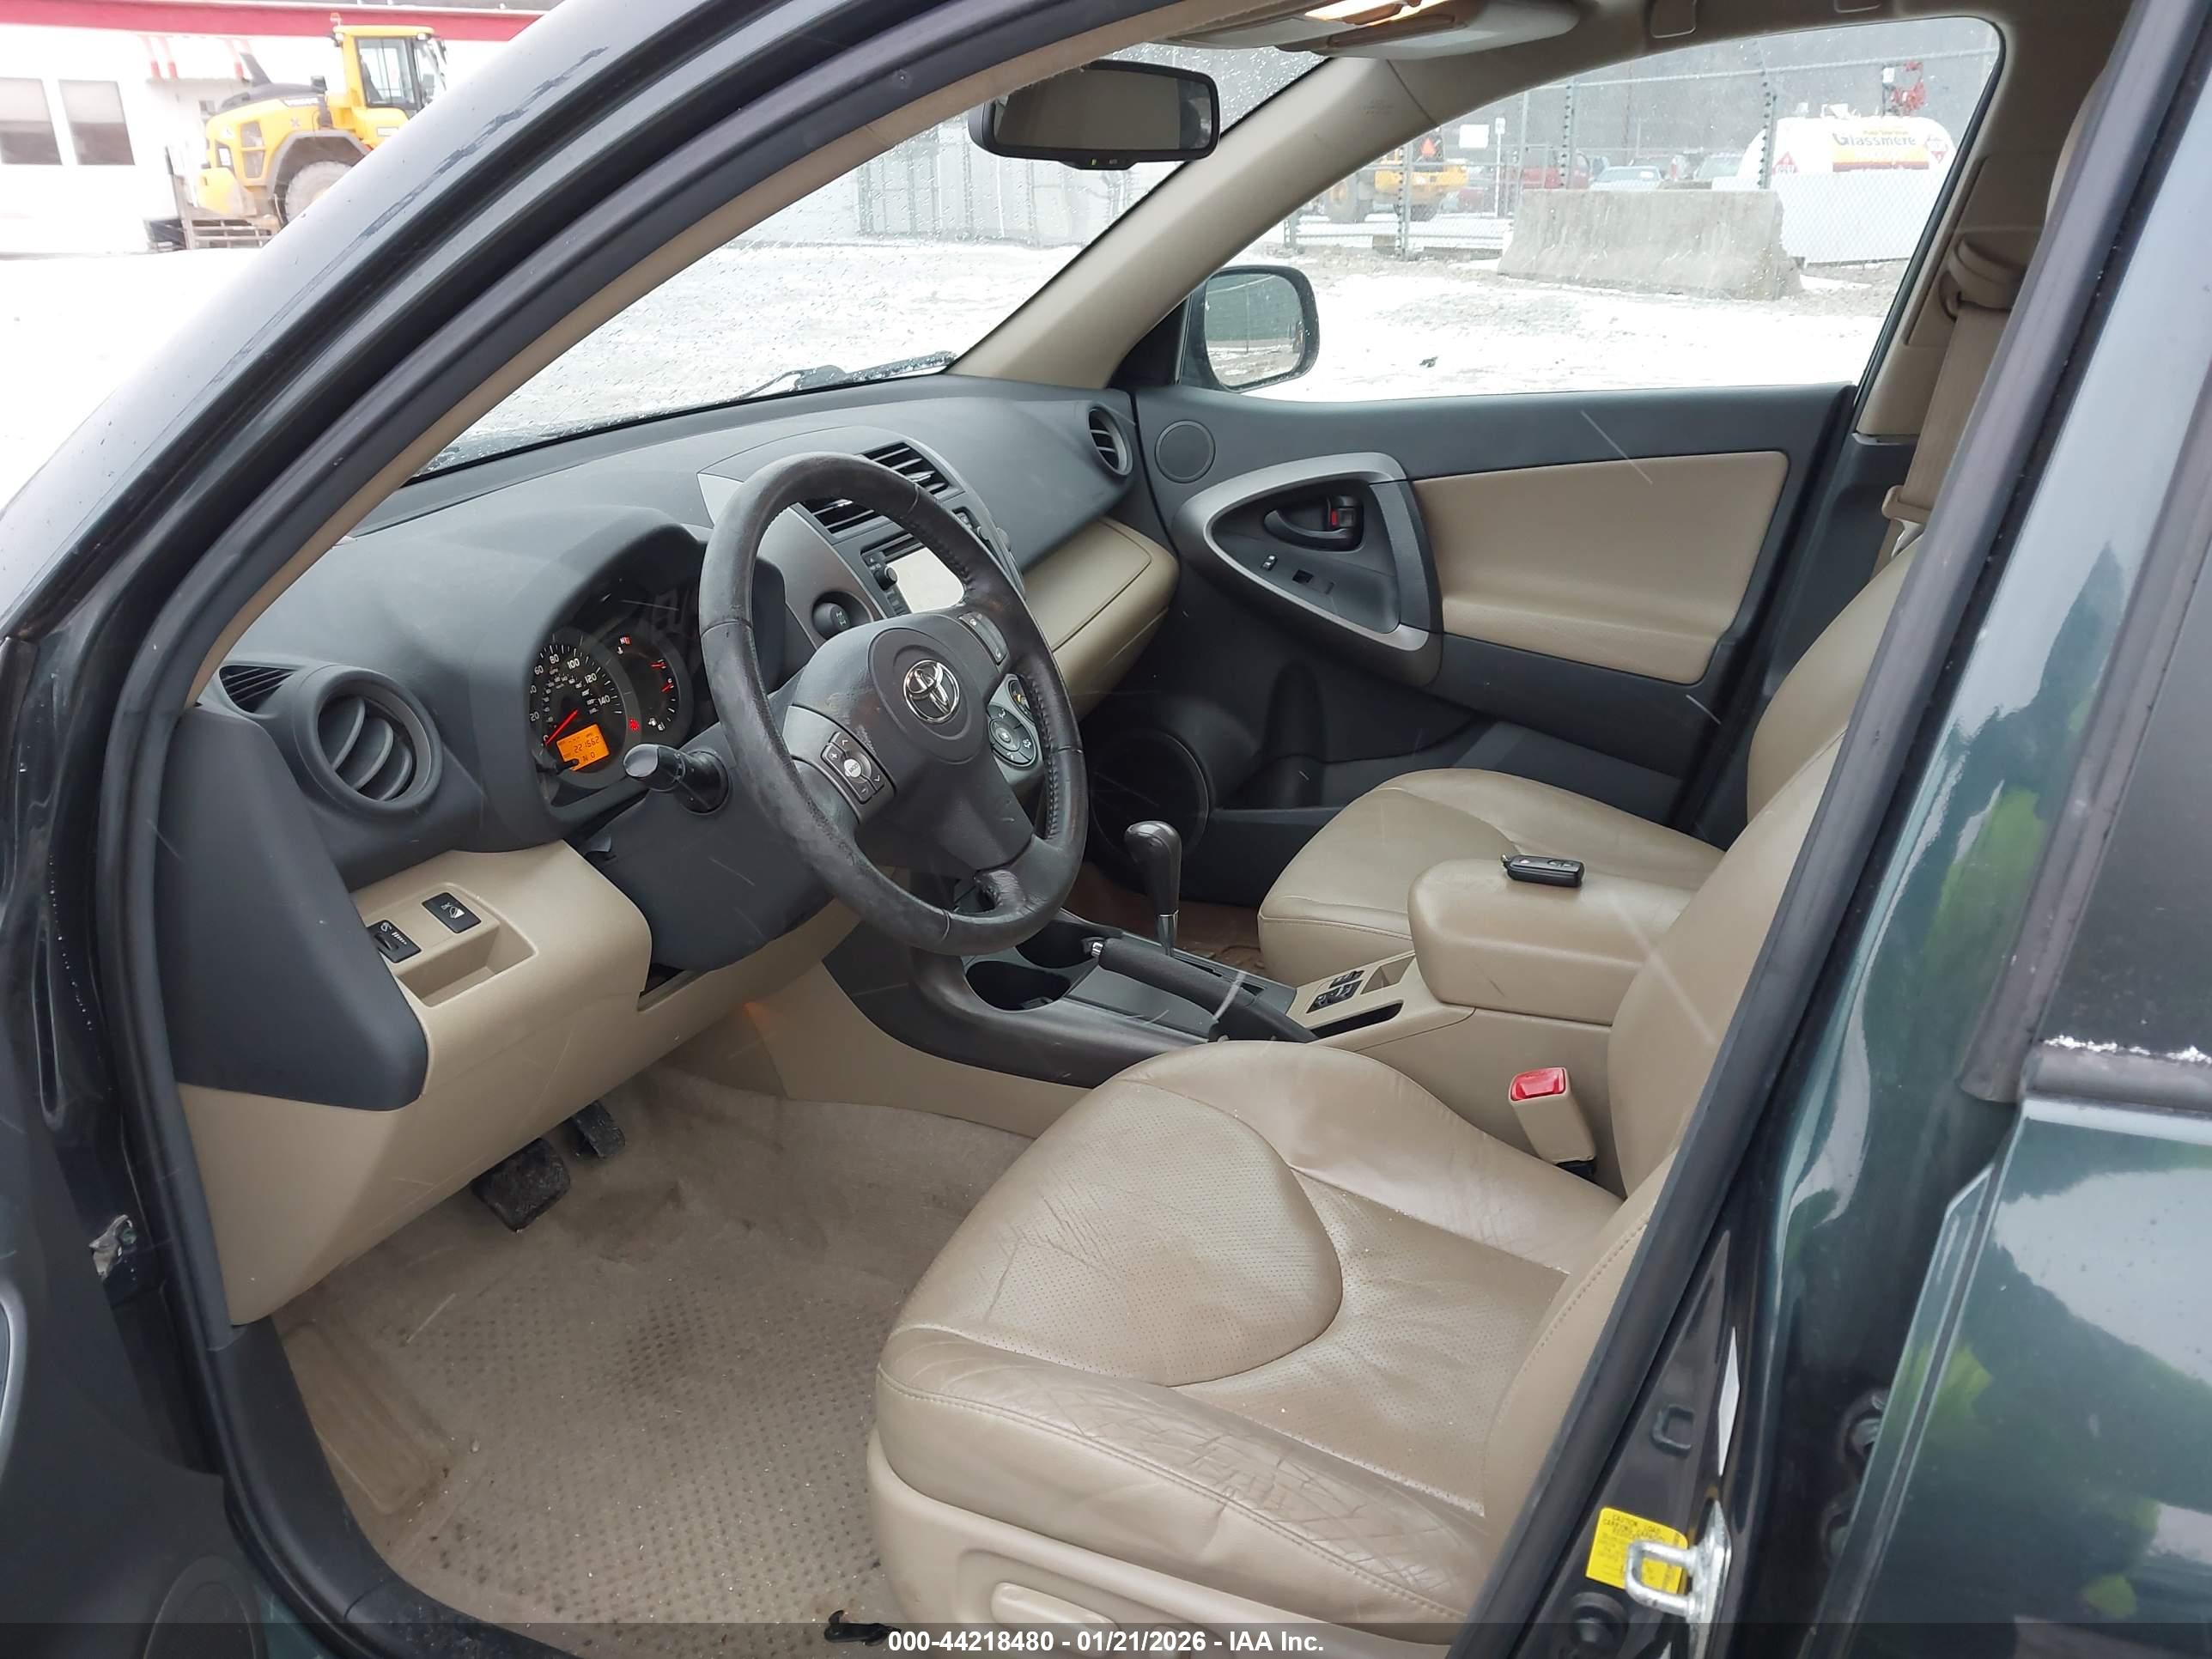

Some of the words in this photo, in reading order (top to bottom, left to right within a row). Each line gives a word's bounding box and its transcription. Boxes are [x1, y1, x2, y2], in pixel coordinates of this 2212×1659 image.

[1832, 132, 1917, 146] Glassmere
[550, 653, 559, 664] 80
[567, 658, 580, 670] 100
[534, 665, 544, 675] 60
[584, 672, 597, 684] 120
[598, 695, 611, 706] 140
[529, 711, 539, 722] 20
